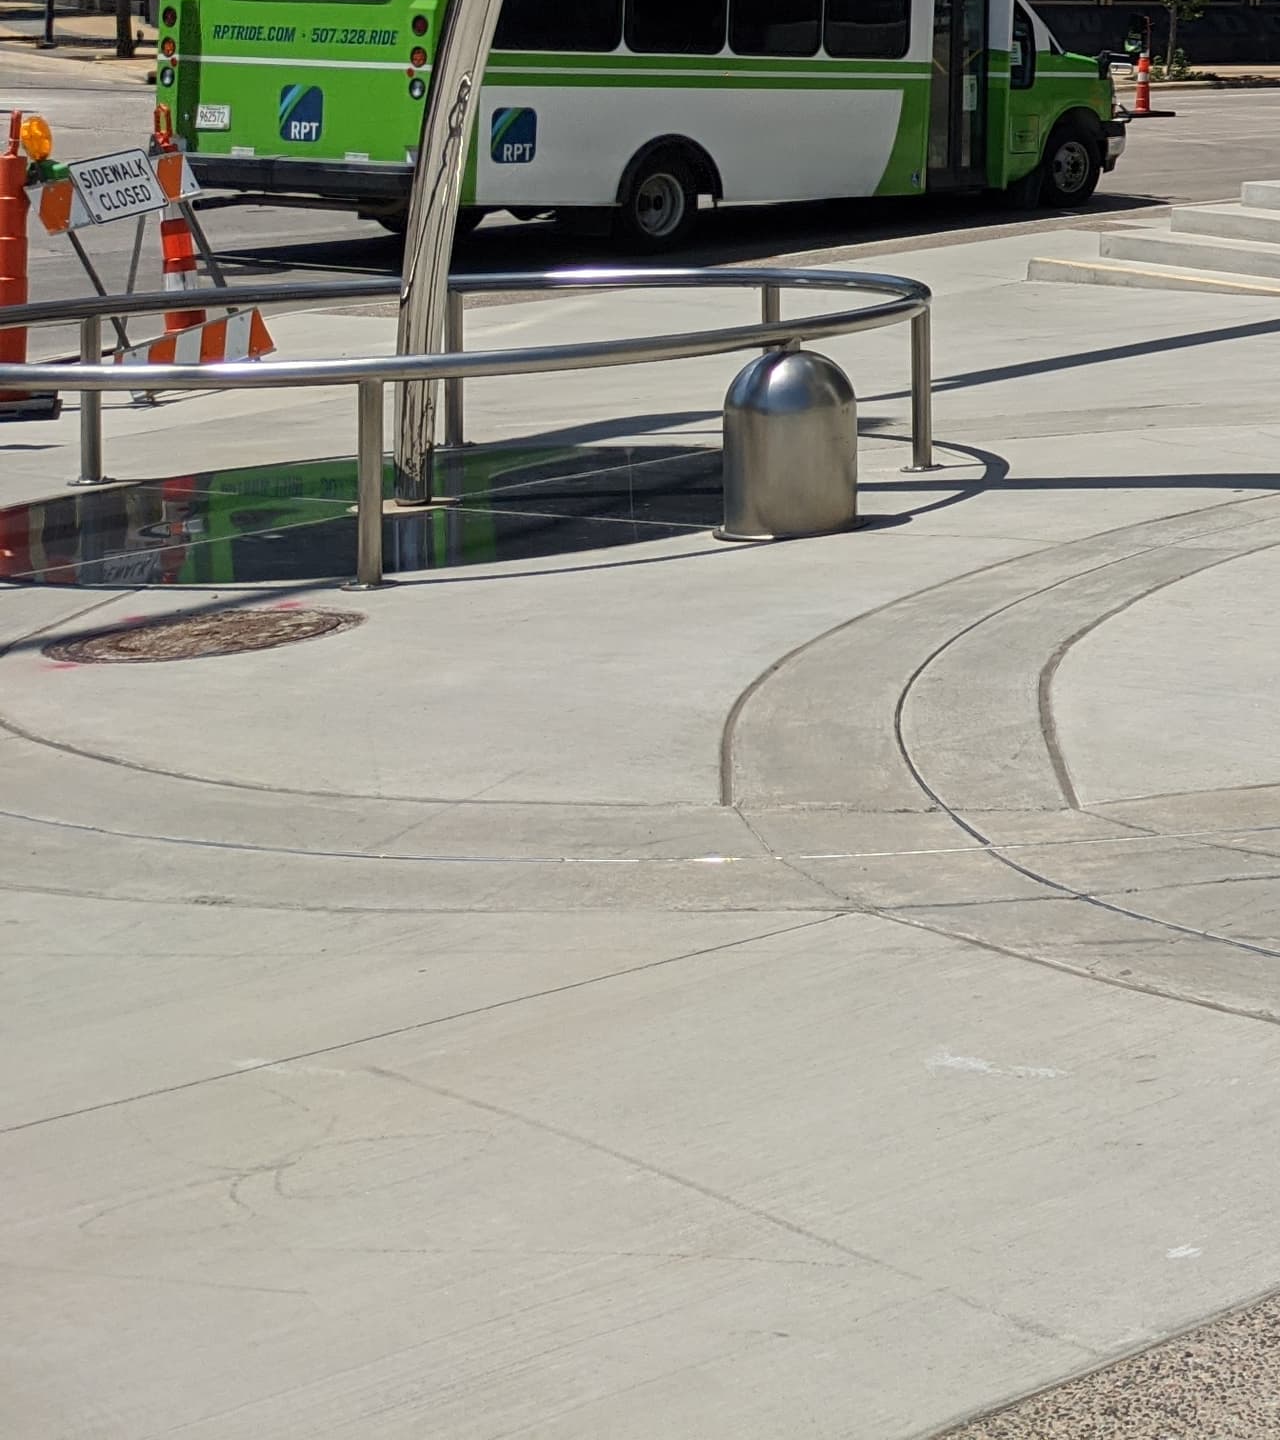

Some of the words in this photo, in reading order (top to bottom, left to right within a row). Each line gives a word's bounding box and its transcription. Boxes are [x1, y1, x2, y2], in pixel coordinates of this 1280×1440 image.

[213, 24, 296, 43] RPTRIDE.COM
[311, 27, 399, 46] 507.328.RIDE
[290, 121, 319, 141] RPT
[503, 143, 533, 162] RPT
[79, 158, 148, 189] SIDEWALK
[99, 184, 152, 211] CLOSED
